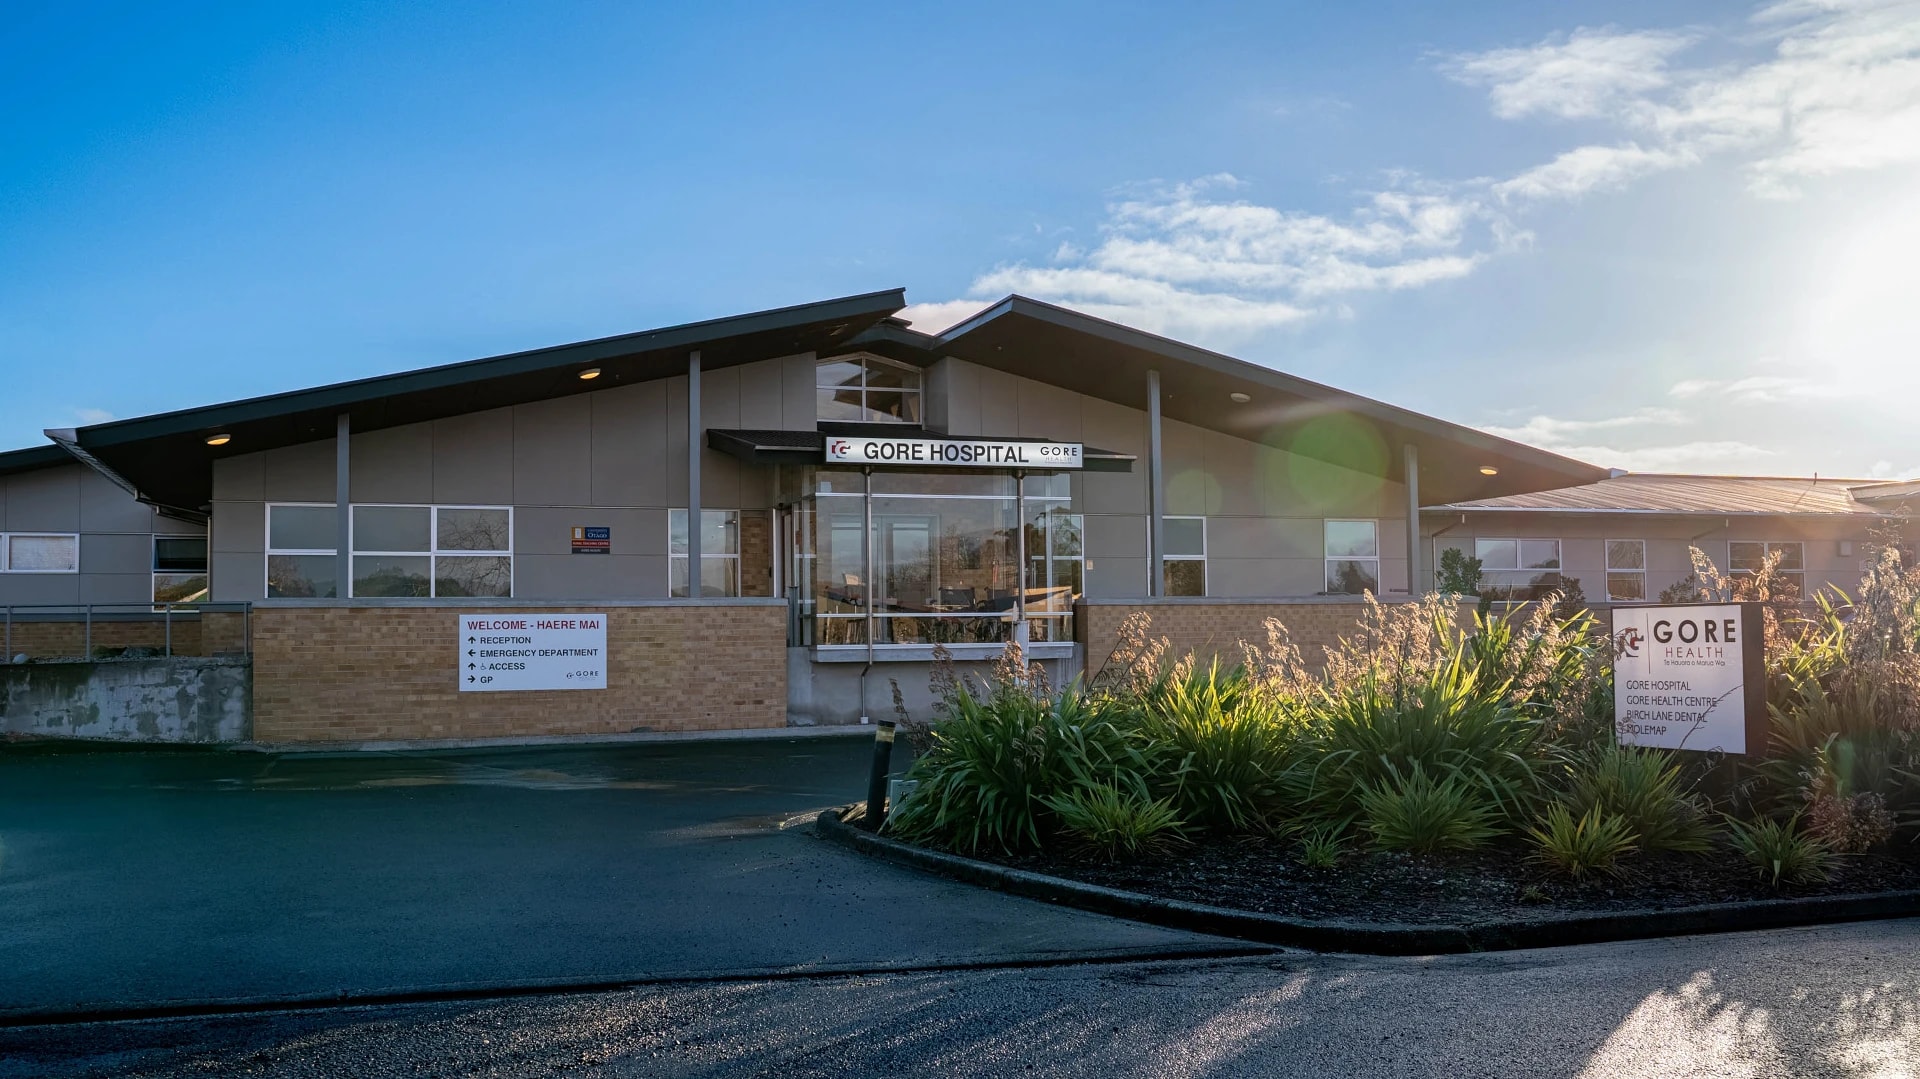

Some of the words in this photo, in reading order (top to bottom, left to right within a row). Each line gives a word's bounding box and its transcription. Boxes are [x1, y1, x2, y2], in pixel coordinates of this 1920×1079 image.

[864, 442, 923, 461] GORE
[931, 443, 1029, 463] HOSPITAL
[1040, 446, 1078, 457] GORE
[467, 620, 527, 630] WELCOME
[537, 620, 576, 630] HAERE
[579, 620, 600, 630] MAI
[1653, 619, 1736, 644] GORE
[480, 636, 531, 645] RECEPTION
[480, 649, 537, 657] EMERGENCY
[538, 648, 598, 657] DEPARTMENT
[1665, 647, 1723, 658] HEALTH
[489, 662, 526, 670] ACCESS
[480, 676, 493, 684] GP
[1626, 680, 1649, 690] GORE
[1651, 680, 1691, 691] HOSPITAL
[1626, 695, 1649, 706] GORE
[1651, 696, 1683, 706] HEALTH
[1684, 697, 1717, 707] CENTRE
[1626, 710, 1650, 720] BIRCH
[1651, 711, 1673, 721] LANE
[1675, 711, 1708, 722] DENTAL
[1626, 724, 1667, 736] MOLEMAP
